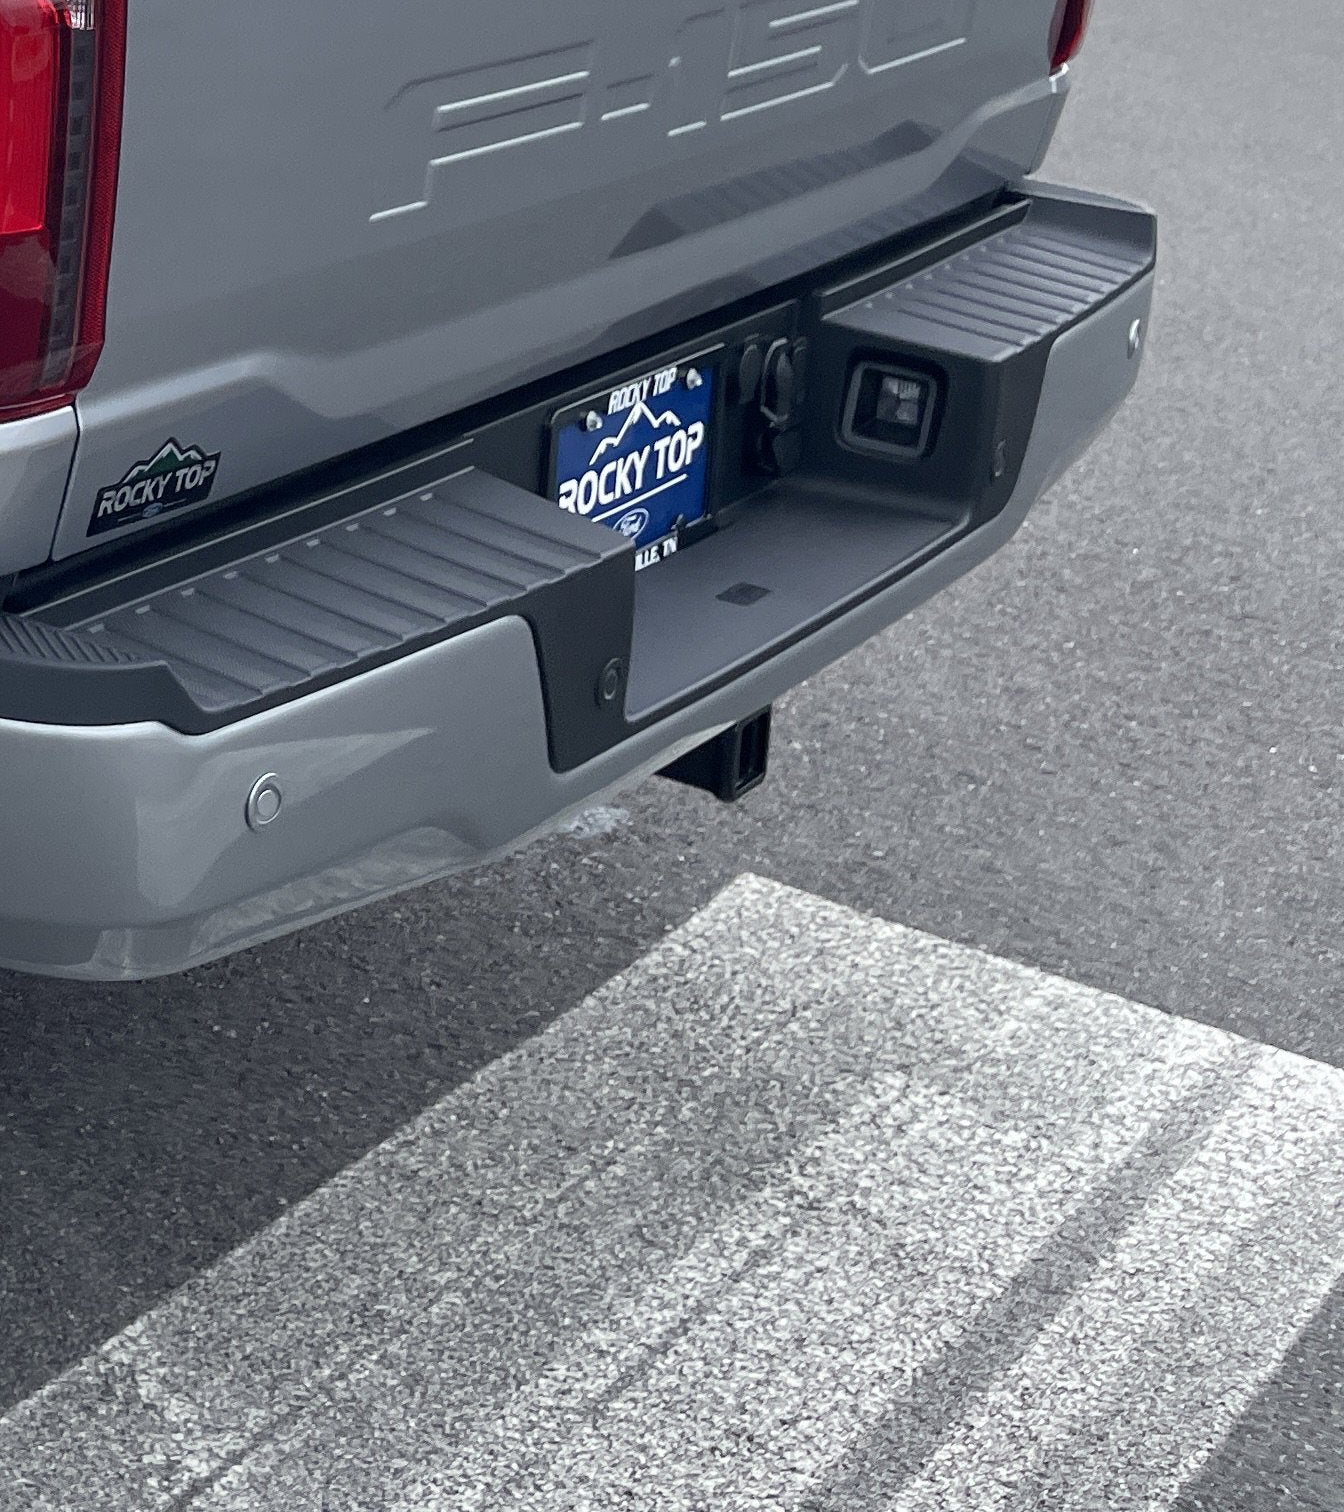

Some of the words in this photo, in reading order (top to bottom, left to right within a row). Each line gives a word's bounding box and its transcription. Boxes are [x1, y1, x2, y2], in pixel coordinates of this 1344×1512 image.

[608, 377, 652, 415] ROCKY
[653, 367, 678, 397] TOP
[97, 472, 173, 519] ROCKY
[175, 460, 217, 493] TOP
[559, 445, 651, 515] ROCKY
[654, 421, 705, 480] TOP
